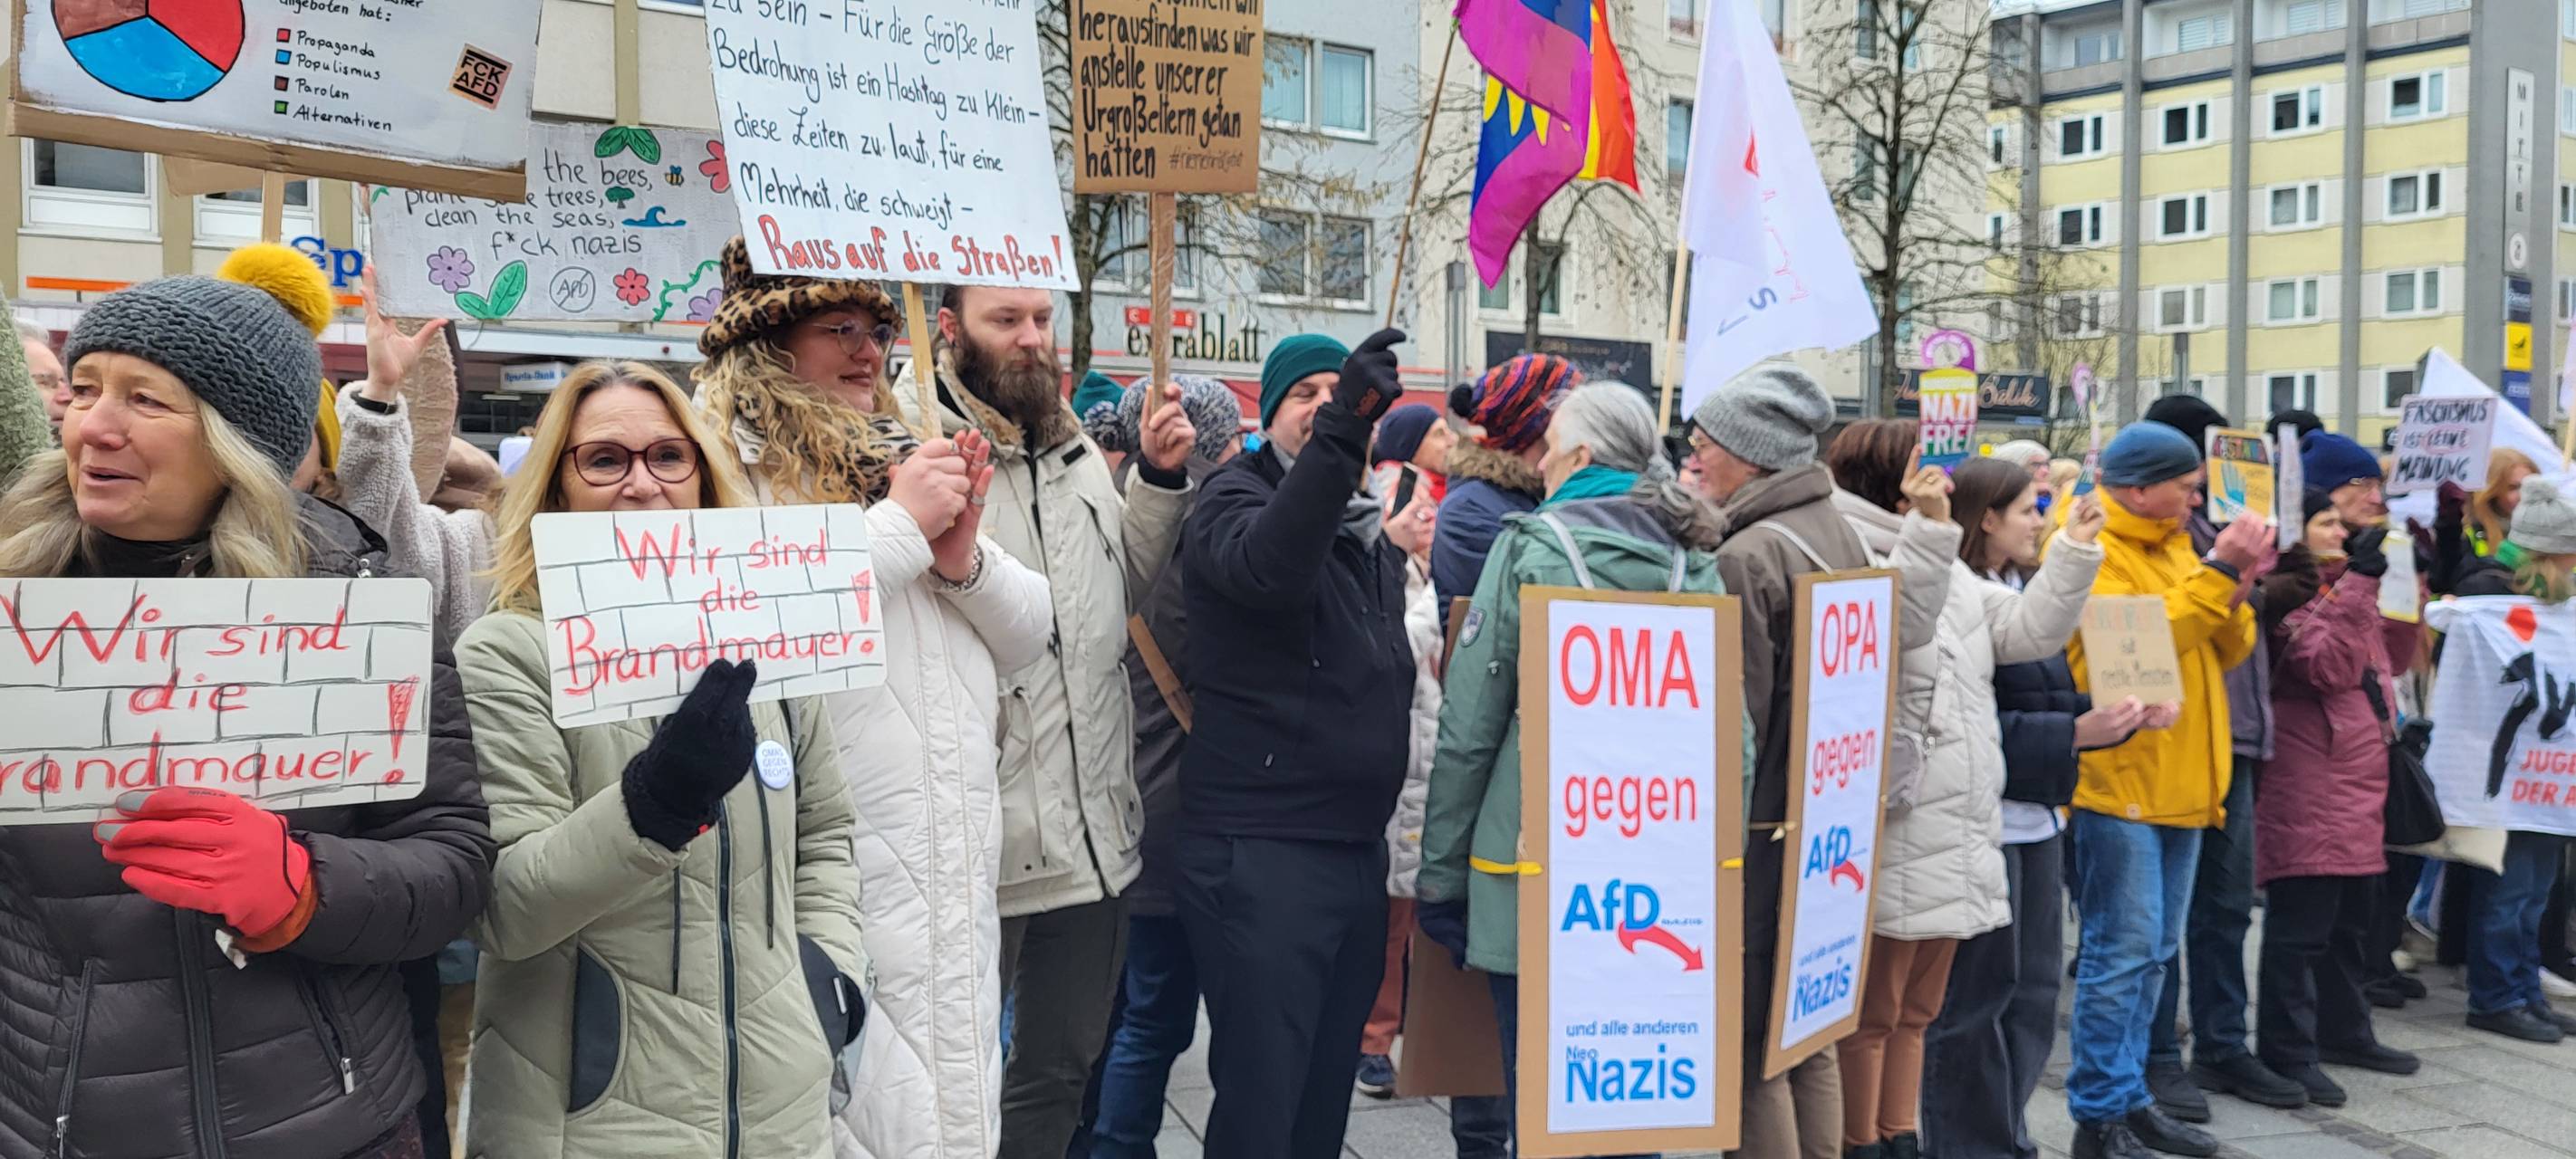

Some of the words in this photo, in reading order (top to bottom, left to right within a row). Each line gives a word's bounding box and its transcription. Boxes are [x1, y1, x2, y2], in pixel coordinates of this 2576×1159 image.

[296, 30, 376, 58] Propaganda
[889, 5, 913, 45] die
[924, 14, 978, 65] Größe
[985, 26, 1015, 63] der
[1079, 0, 1197, 53] herausfinden
[1200, 26, 1228, 53] was
[1235, 25, 1256, 56] wir
[295, 78, 350, 101] Parolen
[296, 53, 380, 81] Populismus
[456, 72, 497, 97] AFD
[461, 56, 505, 84] FCK
[714, 27, 821, 103] Bedrohung
[826, 62, 848, 91] ist
[857, 72, 881, 98] ein
[885, 62, 947, 121] Hashtag
[956, 101, 979, 116] zu
[1081, 43, 1145, 90] anstelle
[1155, 62, 1228, 96] unserer
[293, 104, 392, 131] Alternativen
[734, 101, 782, 142] diese
[788, 106, 850, 152] Zeiten
[861, 134, 882, 156] zu
[939, 129, 966, 171] für
[973, 148, 1004, 172] eine
[1082, 88, 1196, 143] Urgroßeltern
[1199, 98, 1241, 148] getan
[544, 148, 587, 184] the
[601, 159, 653, 191] bees,
[1084, 134, 1156, 178] hätten
[425, 207, 477, 227] clean
[495, 209, 534, 225] the
[553, 210, 615, 228] seas,
[844, 183, 870, 213] die
[880, 189, 954, 231] schweigt
[572, 230, 642, 255] nazis
[758, 214, 842, 273] Raus
[846, 226, 888, 273] auf
[903, 230, 941, 273] die
[951, 234, 1068, 283] Straßen!
[1921, 392, 1977, 422] NAZI
[615, 523, 721, 580] Wir
[746, 528, 831, 570] sind
[698, 577, 761, 613] die
[0, 594, 181, 666] Wir
[206, 604, 351, 656] sind
[1820, 600, 1879, 677] OPA
[129, 667, 249, 715] die
[1560, 624, 1699, 709] OMA
[0, 675, 419, 797] randmauer!
[1812, 727, 1876, 796] gegen
[1564, 774, 1697, 838] gegen
[2512, 780, 2559, 805] DER
[1804, 825, 1851, 880] AfD
[1561, 879, 1661, 931] AfD
[1793, 955, 1851, 1022] Nazis
[1566, 1021, 1598, 1037] und
[1600, 1020, 1628, 1036] alle
[1632, 1020, 1698, 1035] anderen
[1566, 1046, 1599, 1060] Neo
[1566, 1044, 1697, 1103] Nazis
